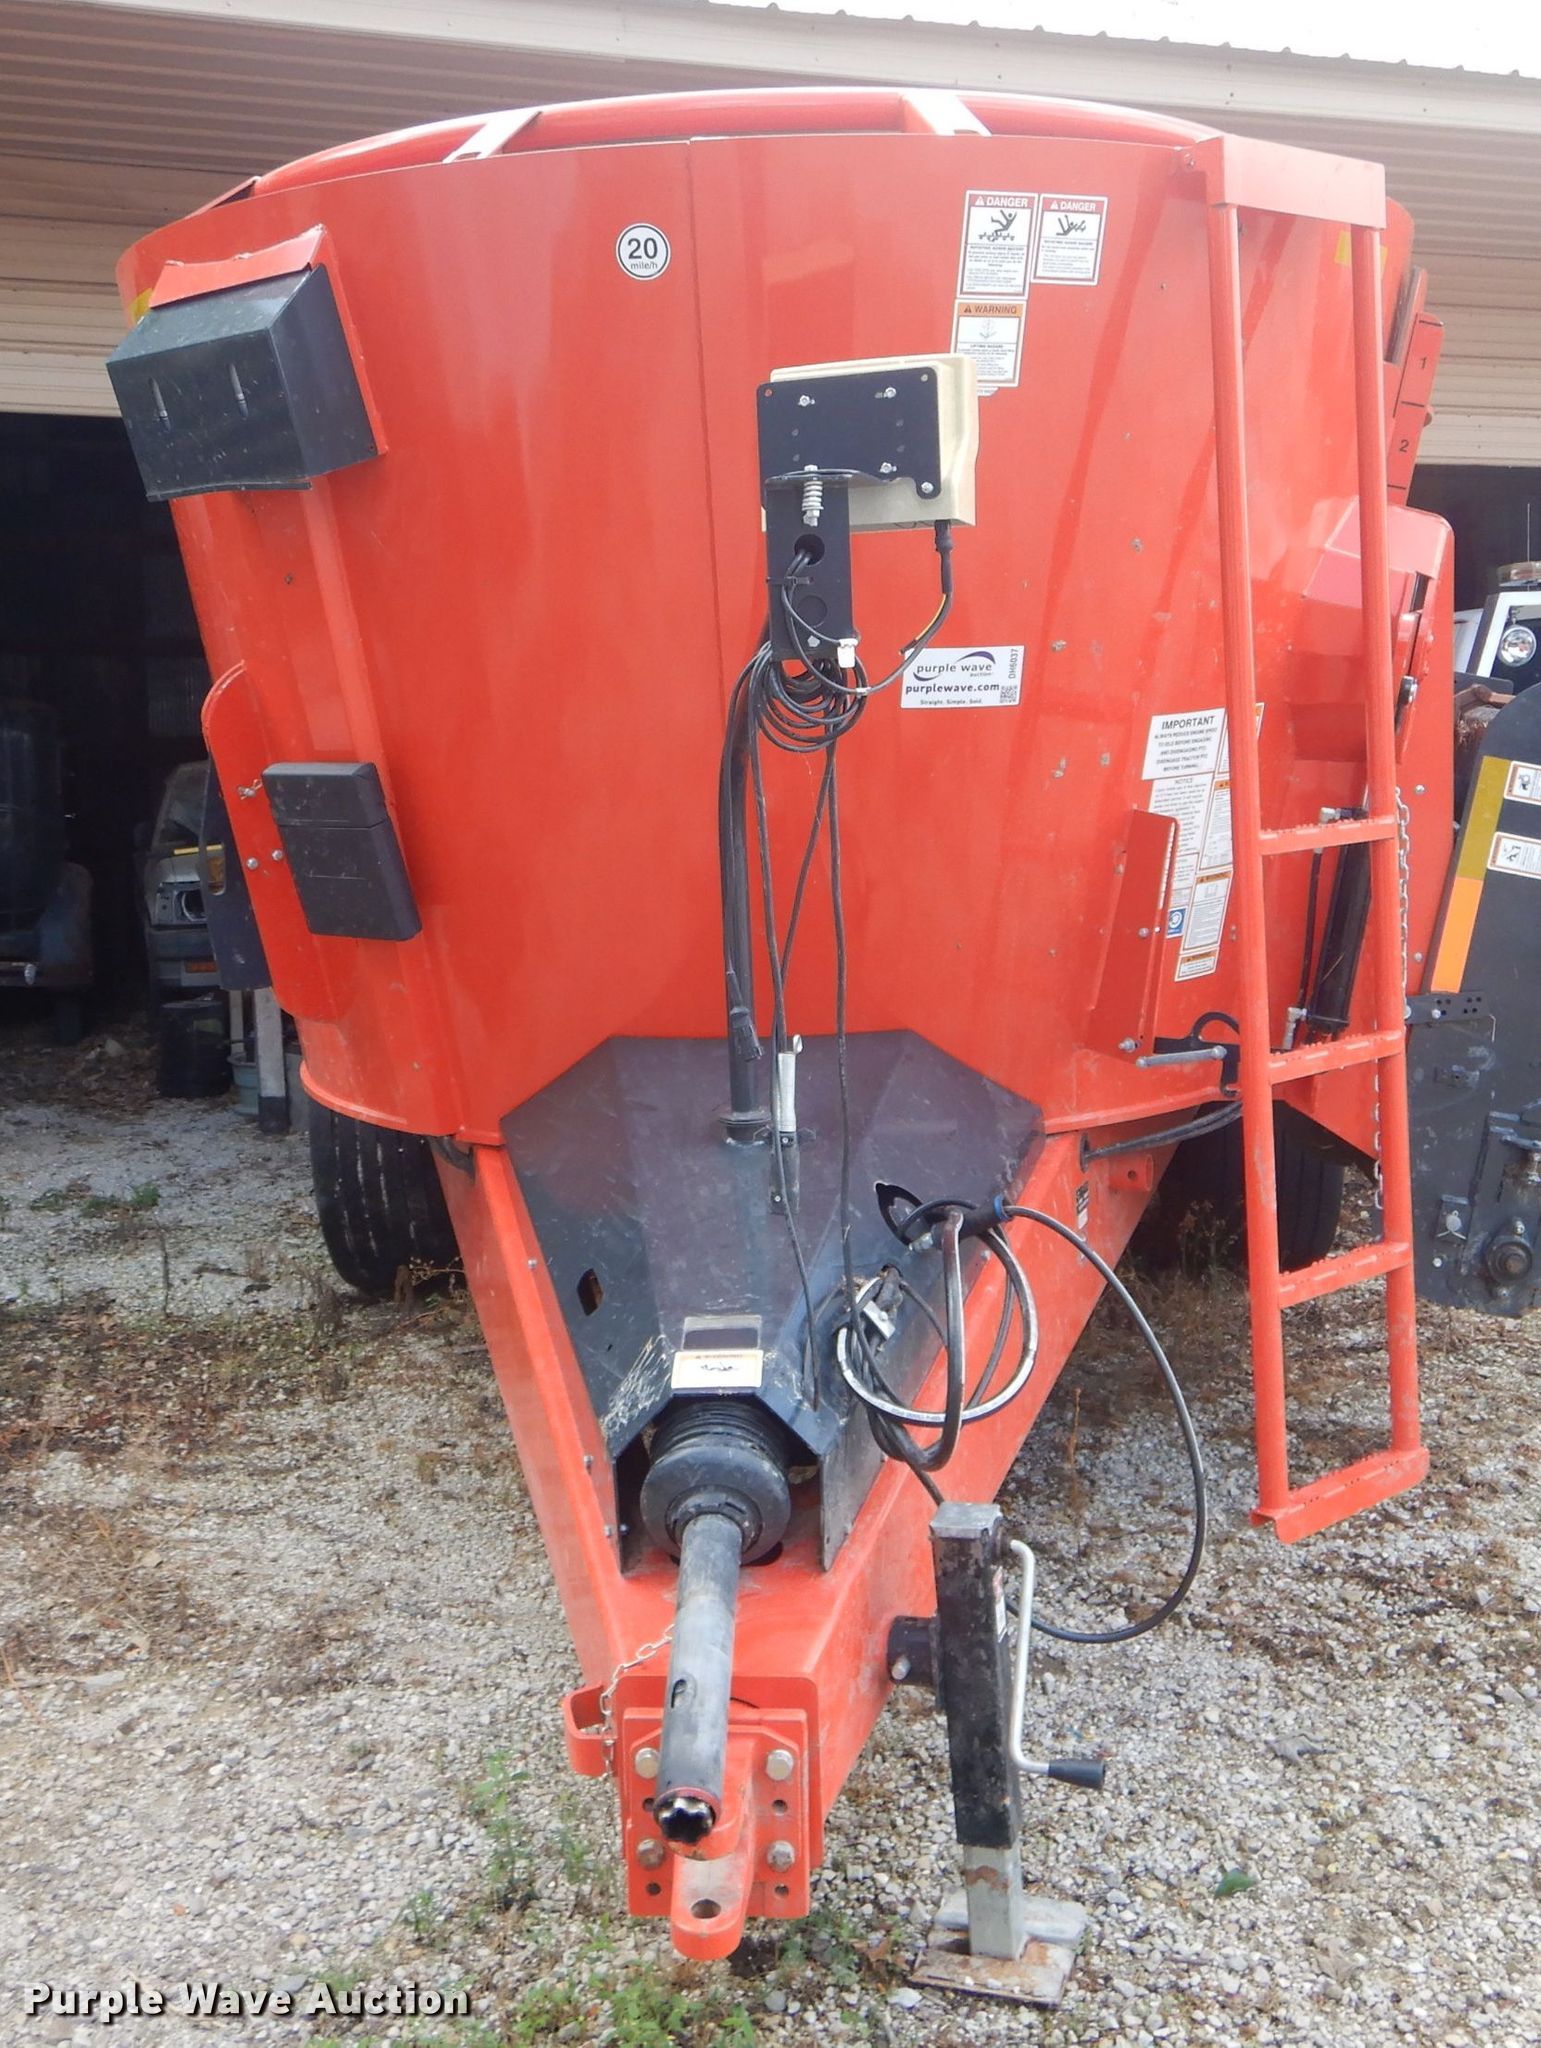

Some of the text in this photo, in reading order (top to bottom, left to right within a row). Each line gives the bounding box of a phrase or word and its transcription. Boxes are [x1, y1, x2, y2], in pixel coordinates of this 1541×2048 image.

[986, 197, 1028, 207] DANGER
[1060, 201, 1097, 211] DANGER
[627, 237, 658, 260] 20
[630, 261, 658, 270] mile/h
[974, 305, 1018, 314] WARNING
[1420, 357, 1427, 370] 1
[1399, 439, 1409, 453] 2
[916, 664, 992, 674] purple wave
[905, 684, 1000, 694] purplewave.com
[1161, 716, 1215, 729] IMPORTANT
